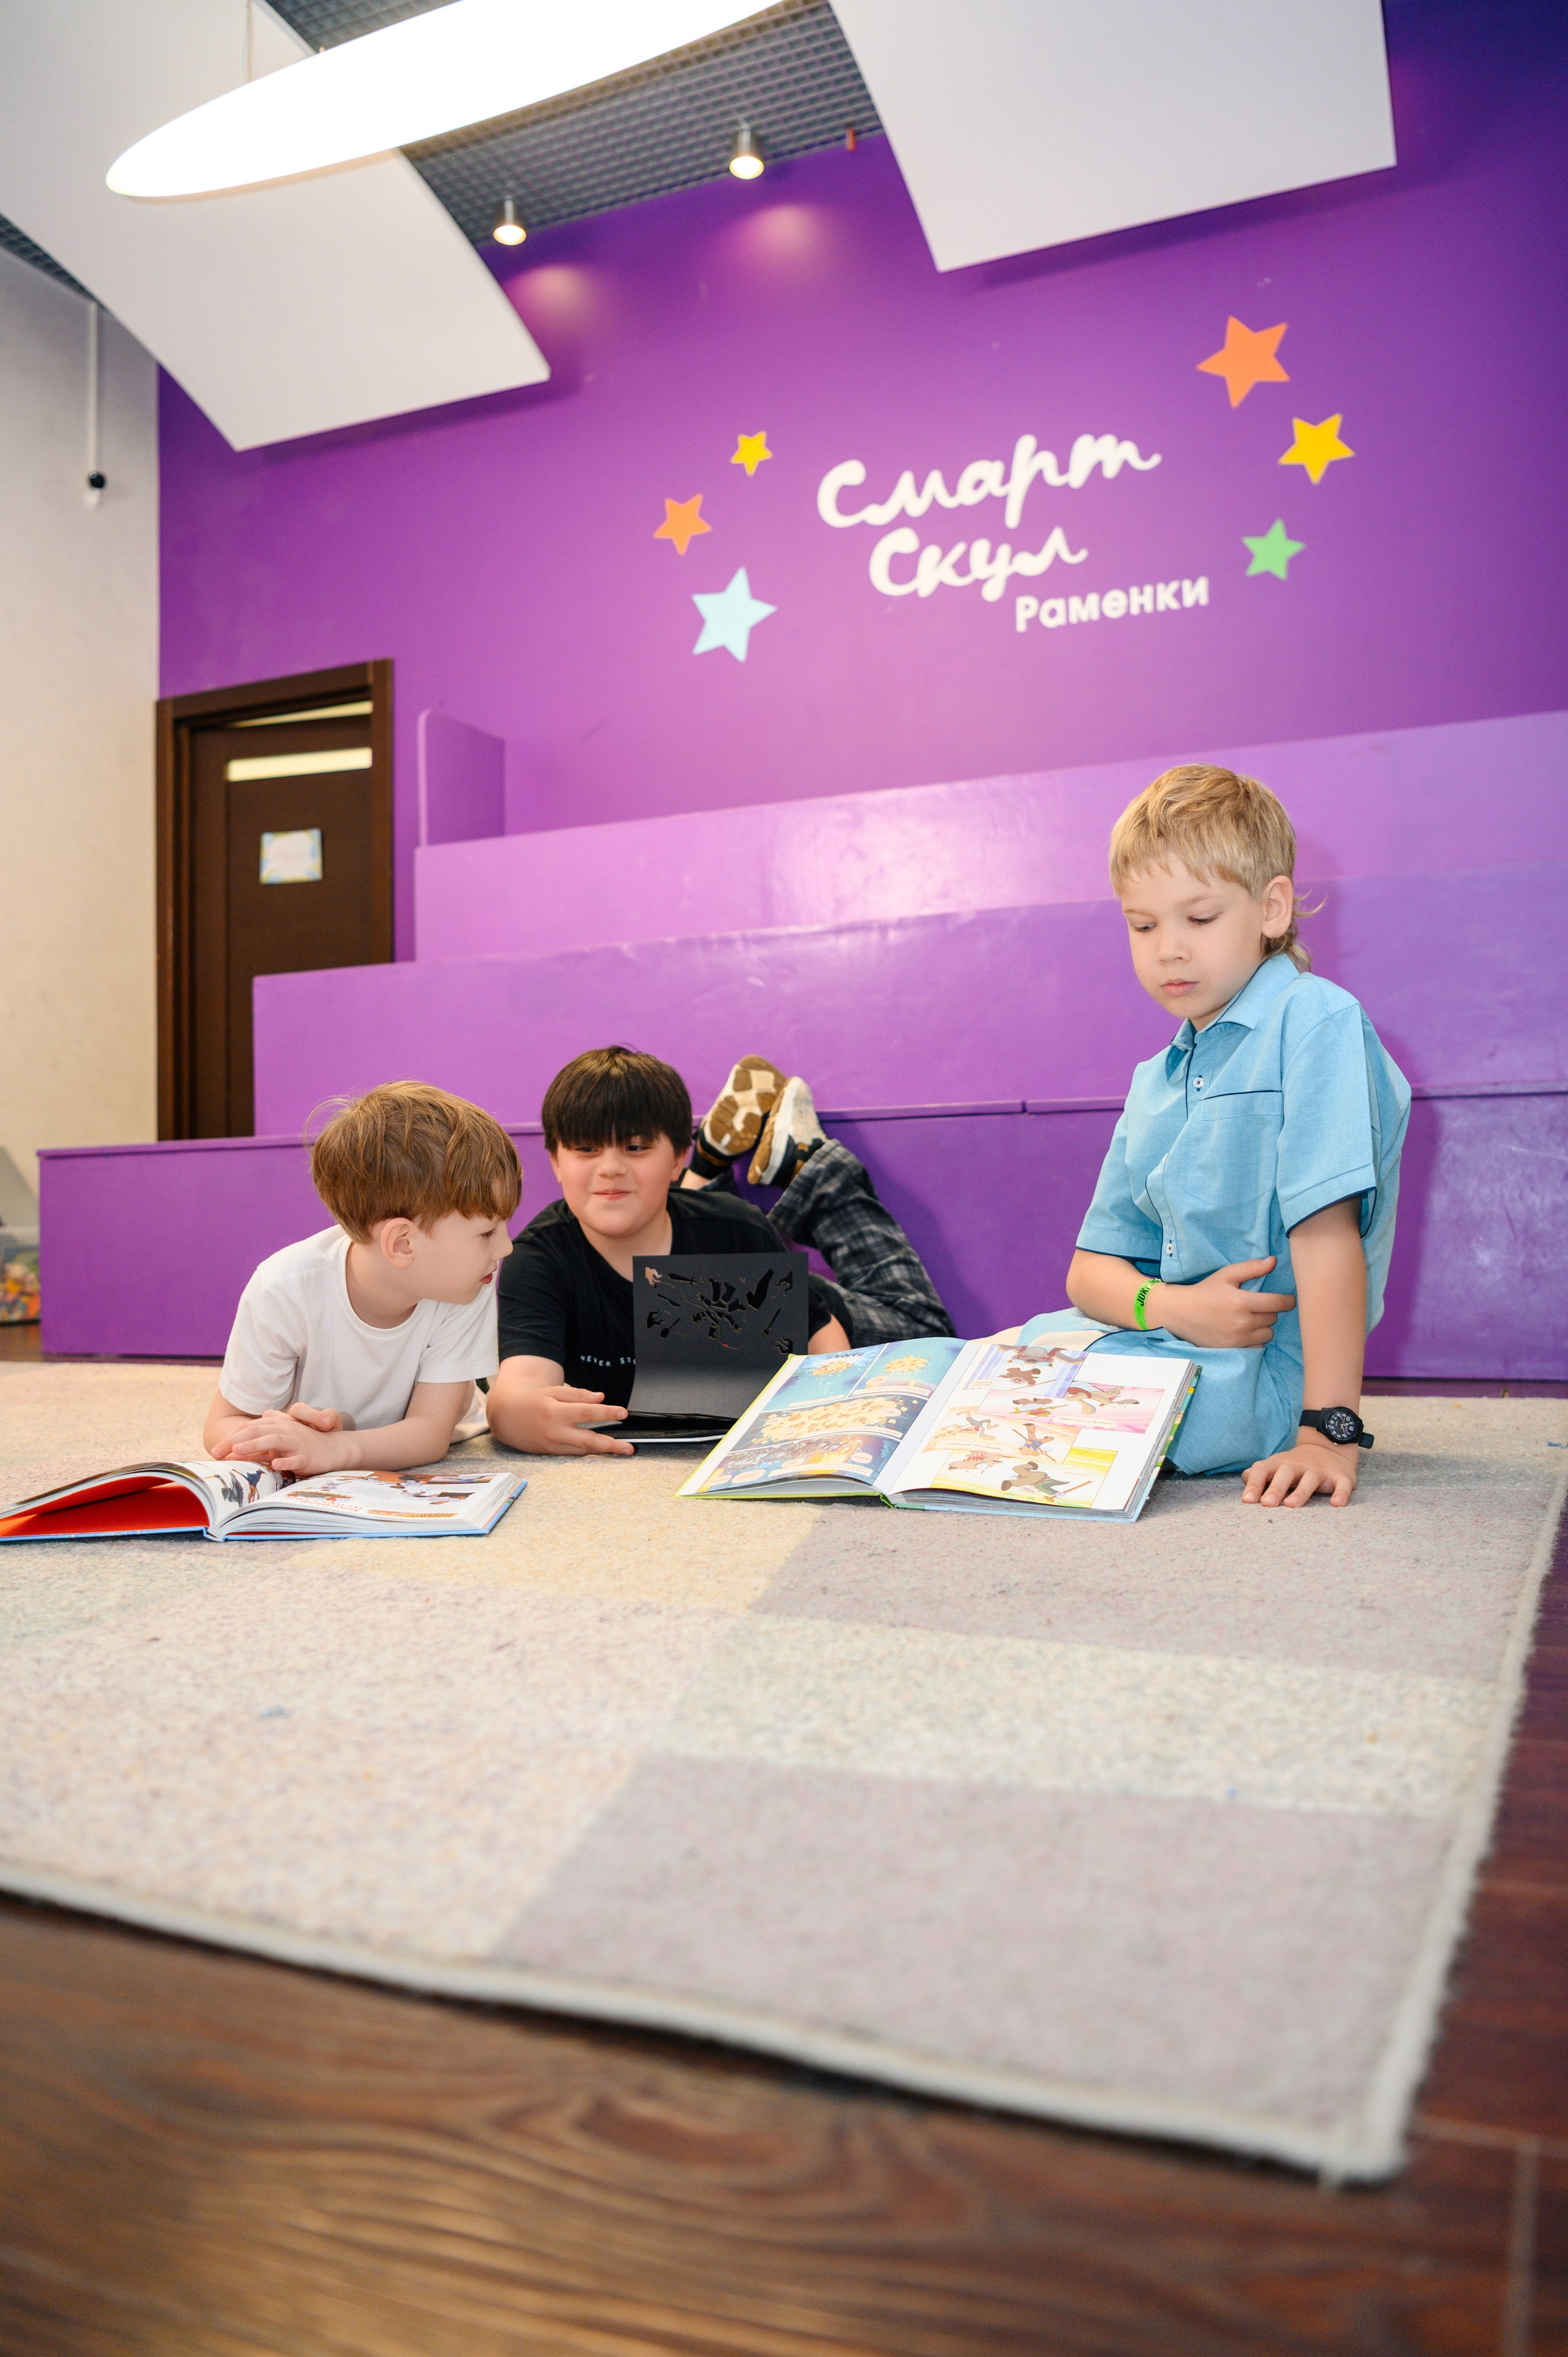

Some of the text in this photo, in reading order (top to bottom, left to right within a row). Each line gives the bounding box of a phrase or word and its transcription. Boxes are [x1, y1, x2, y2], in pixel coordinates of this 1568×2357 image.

[816, 433, 1163, 529] Смарт
[868, 526, 1089, 603] Скул
[1014, 576, 1210, 633] Раменки
[581, 1355, 611, 1366] NEVER
